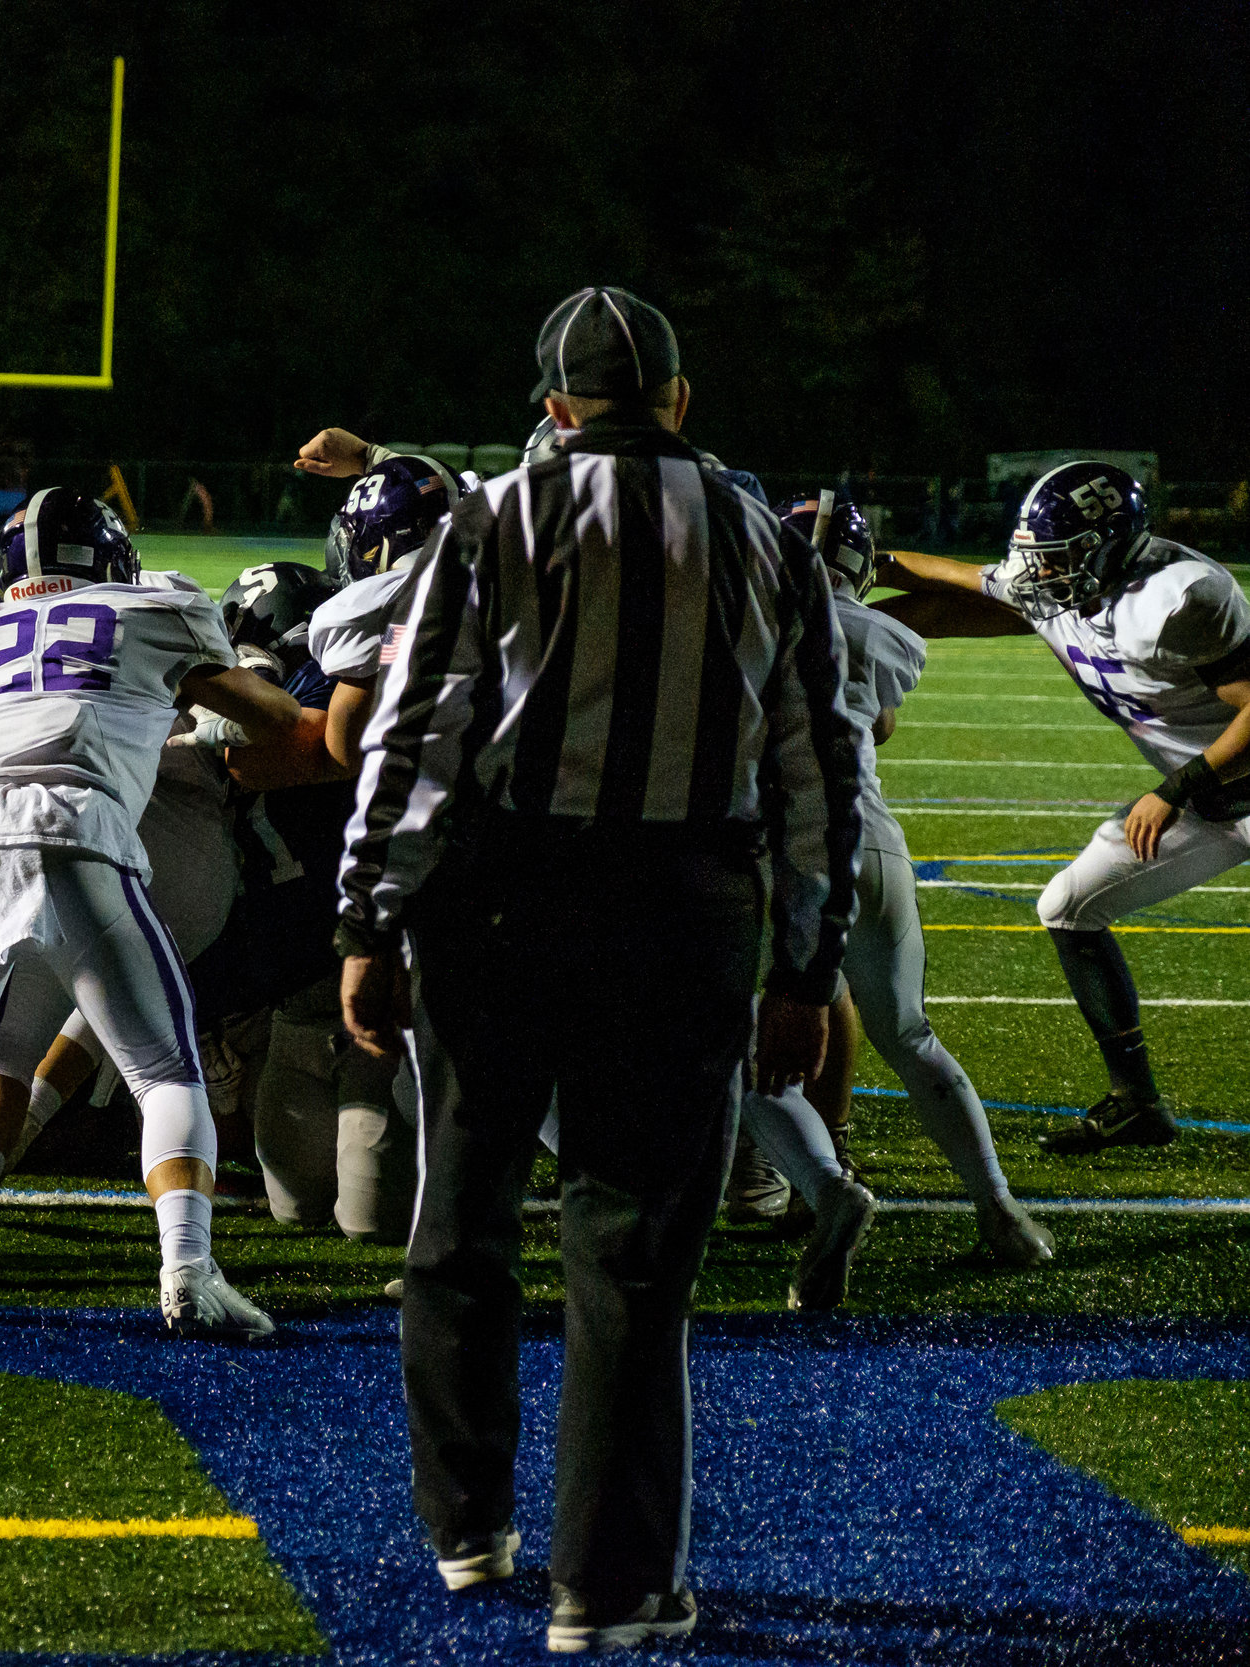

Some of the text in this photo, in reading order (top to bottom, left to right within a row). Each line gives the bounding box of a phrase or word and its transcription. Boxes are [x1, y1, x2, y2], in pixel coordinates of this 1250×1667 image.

[1069, 475, 1124, 520] 55
[10, 578, 72, 601] Riddell
[238, 562, 279, 602] S
